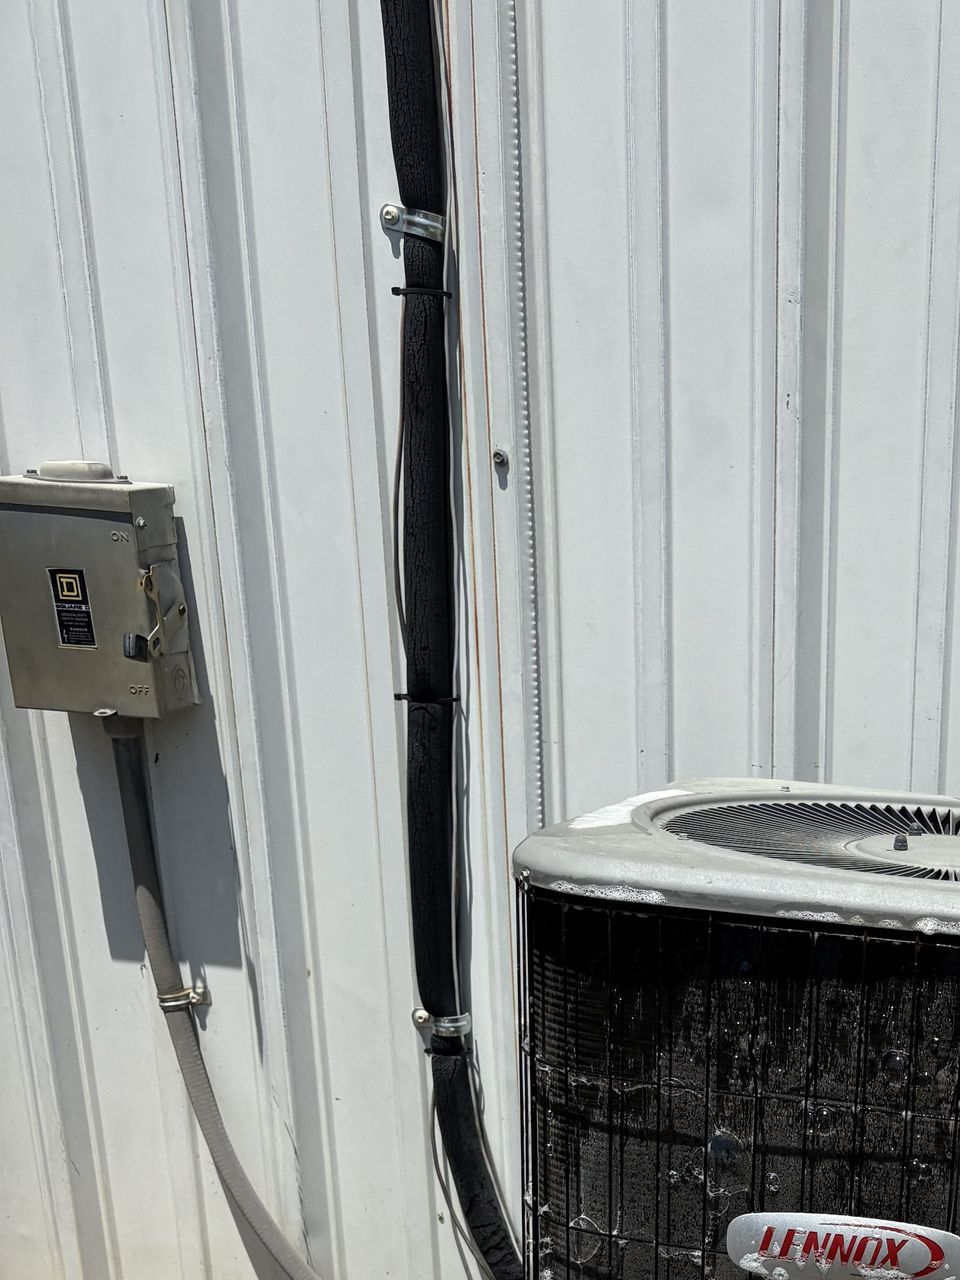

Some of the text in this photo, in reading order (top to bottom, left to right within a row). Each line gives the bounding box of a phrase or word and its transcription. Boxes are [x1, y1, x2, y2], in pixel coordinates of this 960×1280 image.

[111, 531, 129, 543] ON
[129, 685, 149, 696] OFF
[757, 1226, 908, 1270] LENNOX
